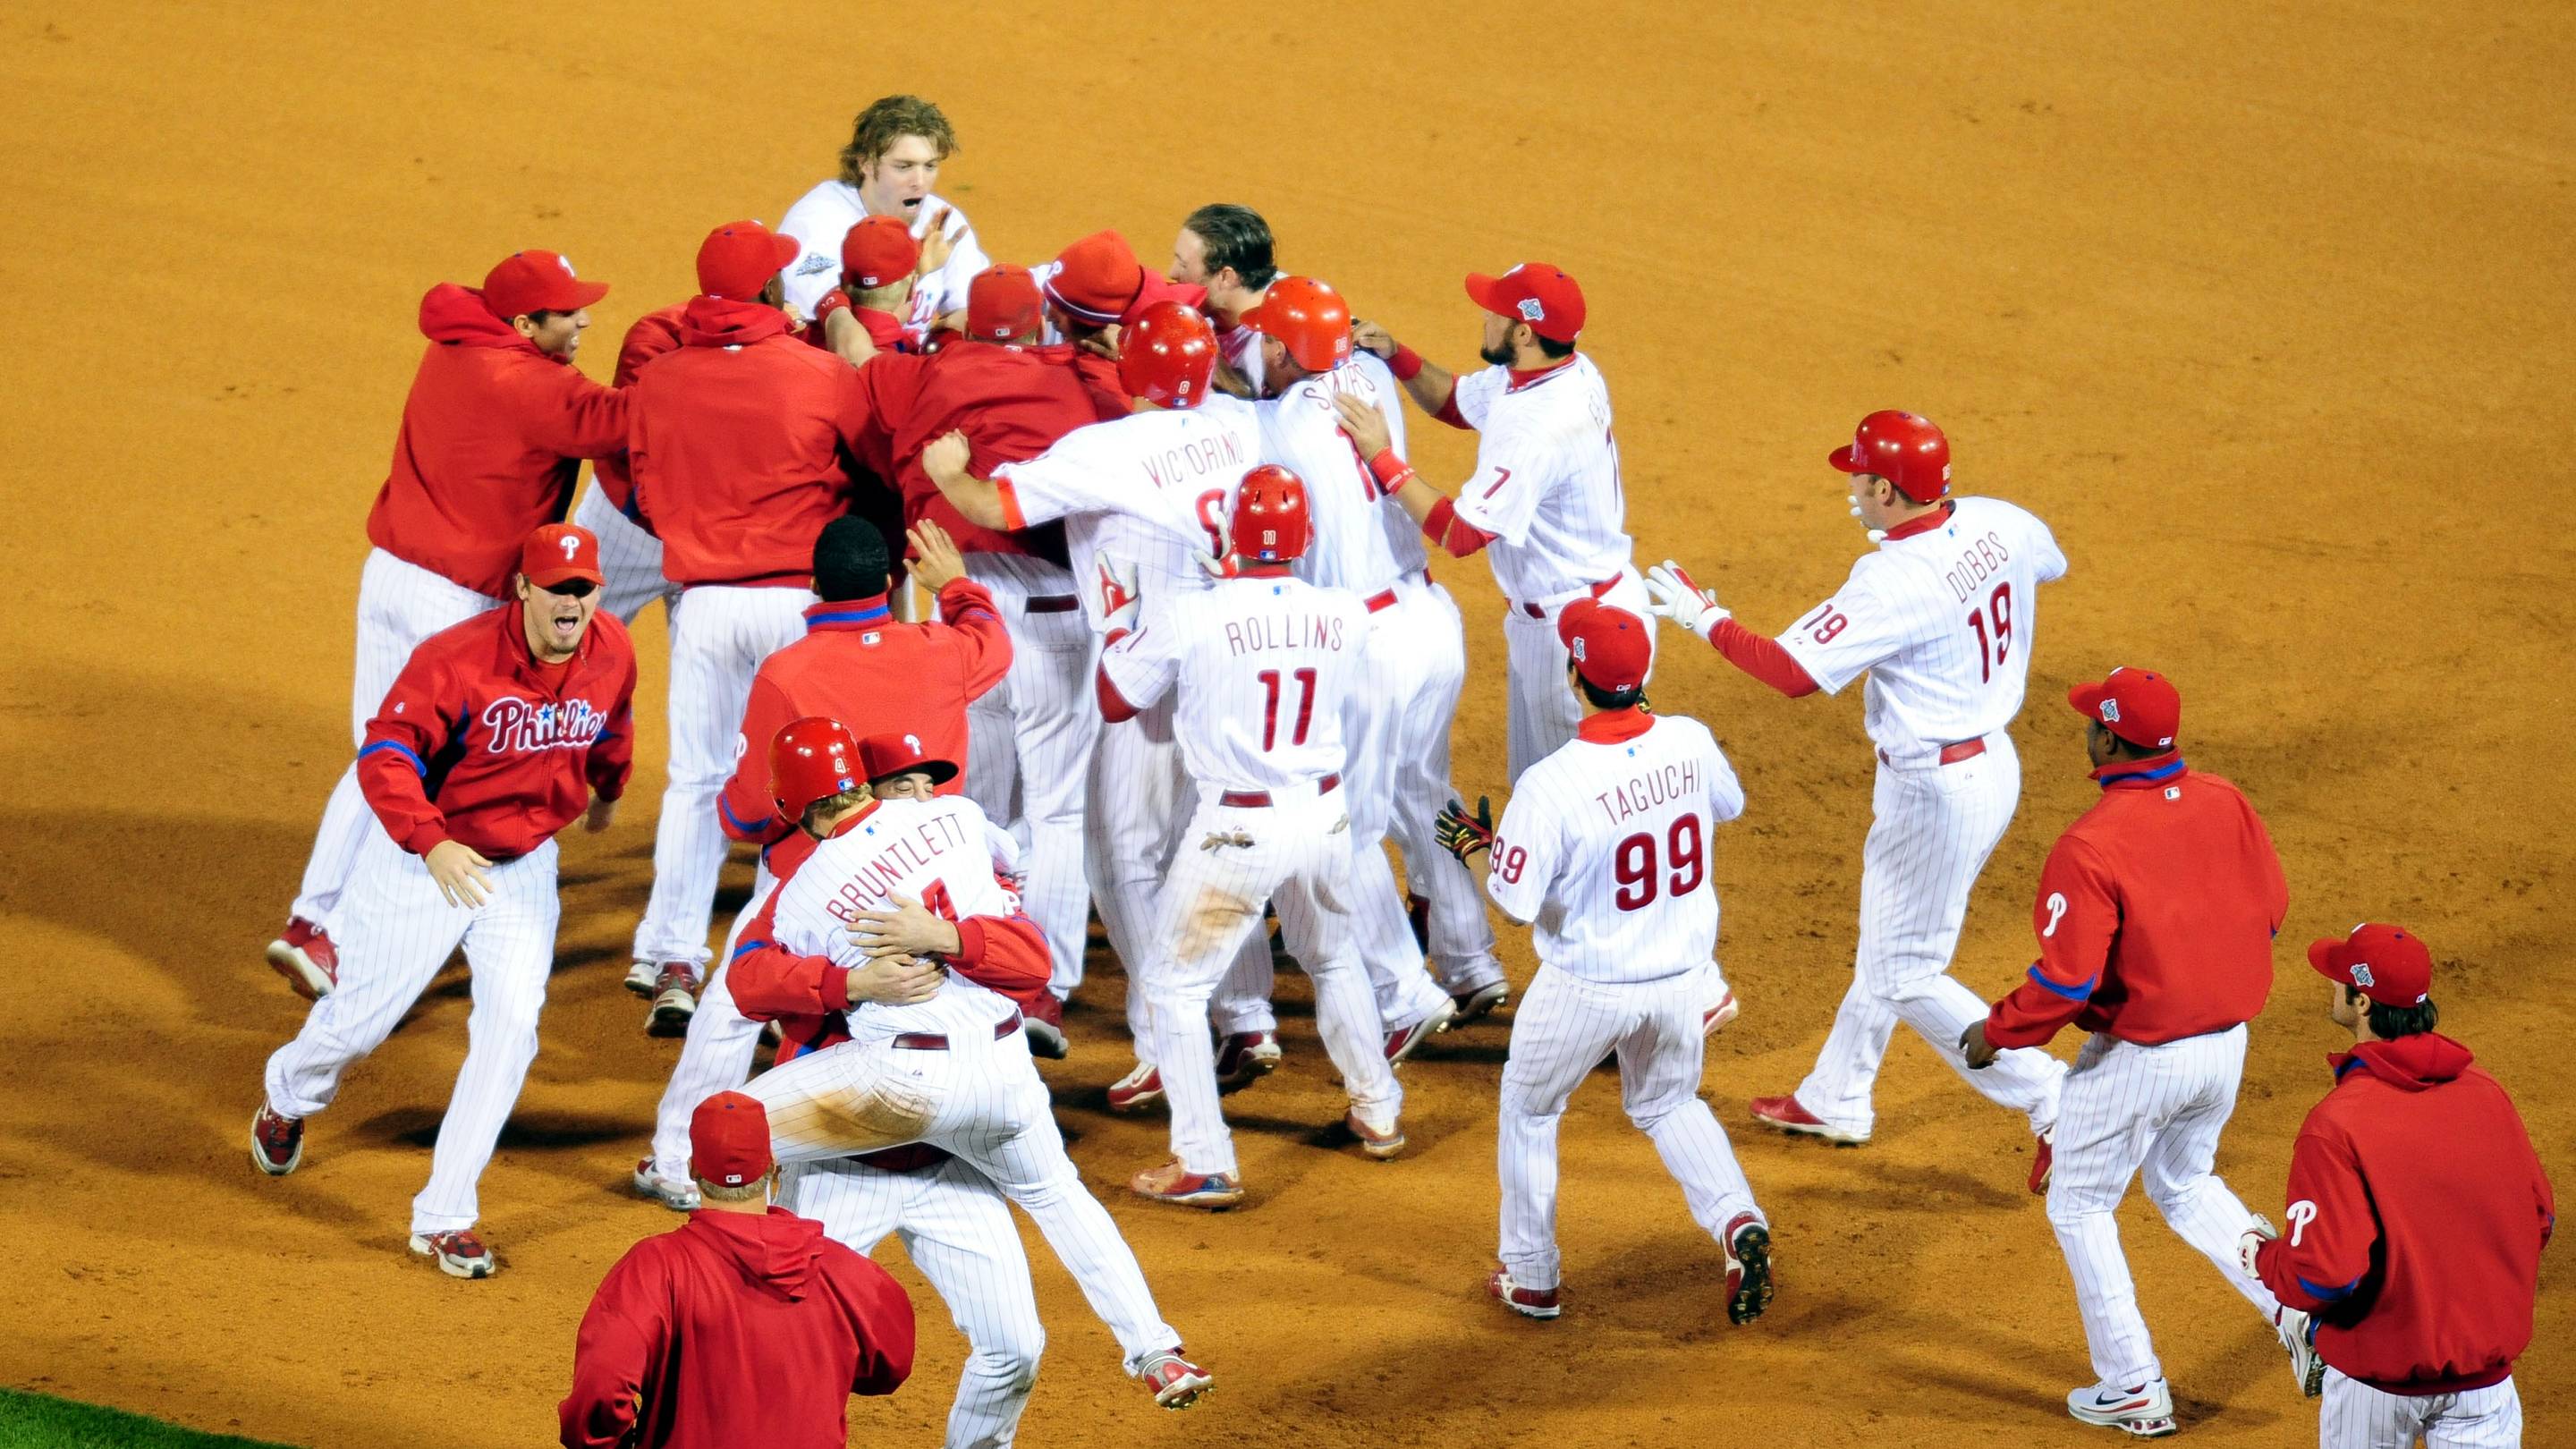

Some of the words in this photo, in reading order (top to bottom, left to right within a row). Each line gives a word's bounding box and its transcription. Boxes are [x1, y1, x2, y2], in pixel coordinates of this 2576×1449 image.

[1178, 380, 1191, 394] 8
[1484, 465, 1511, 500] 7
[560, 535, 580, 561] P
[1263, 530, 1276, 546] 11
[1946, 531, 2009, 605] DOBBS
[1224, 614, 1343, 657] ROLLINS
[1802, 604, 1848, 645] 19
[1968, 580, 2012, 684] 19
[1258, 667, 1318, 752] 11
[834, 757, 846, 774] 4
[903, 733, 921, 756] P
[1596, 758, 1700, 826] TAGUCHI
[826, 813, 966, 923] BRUNTLETT
[1491, 835, 1528, 885] 99
[1614, 811, 1704, 913] 99
[2042, 892, 2068, 937] P
[2285, 1199, 2318, 1247] P
